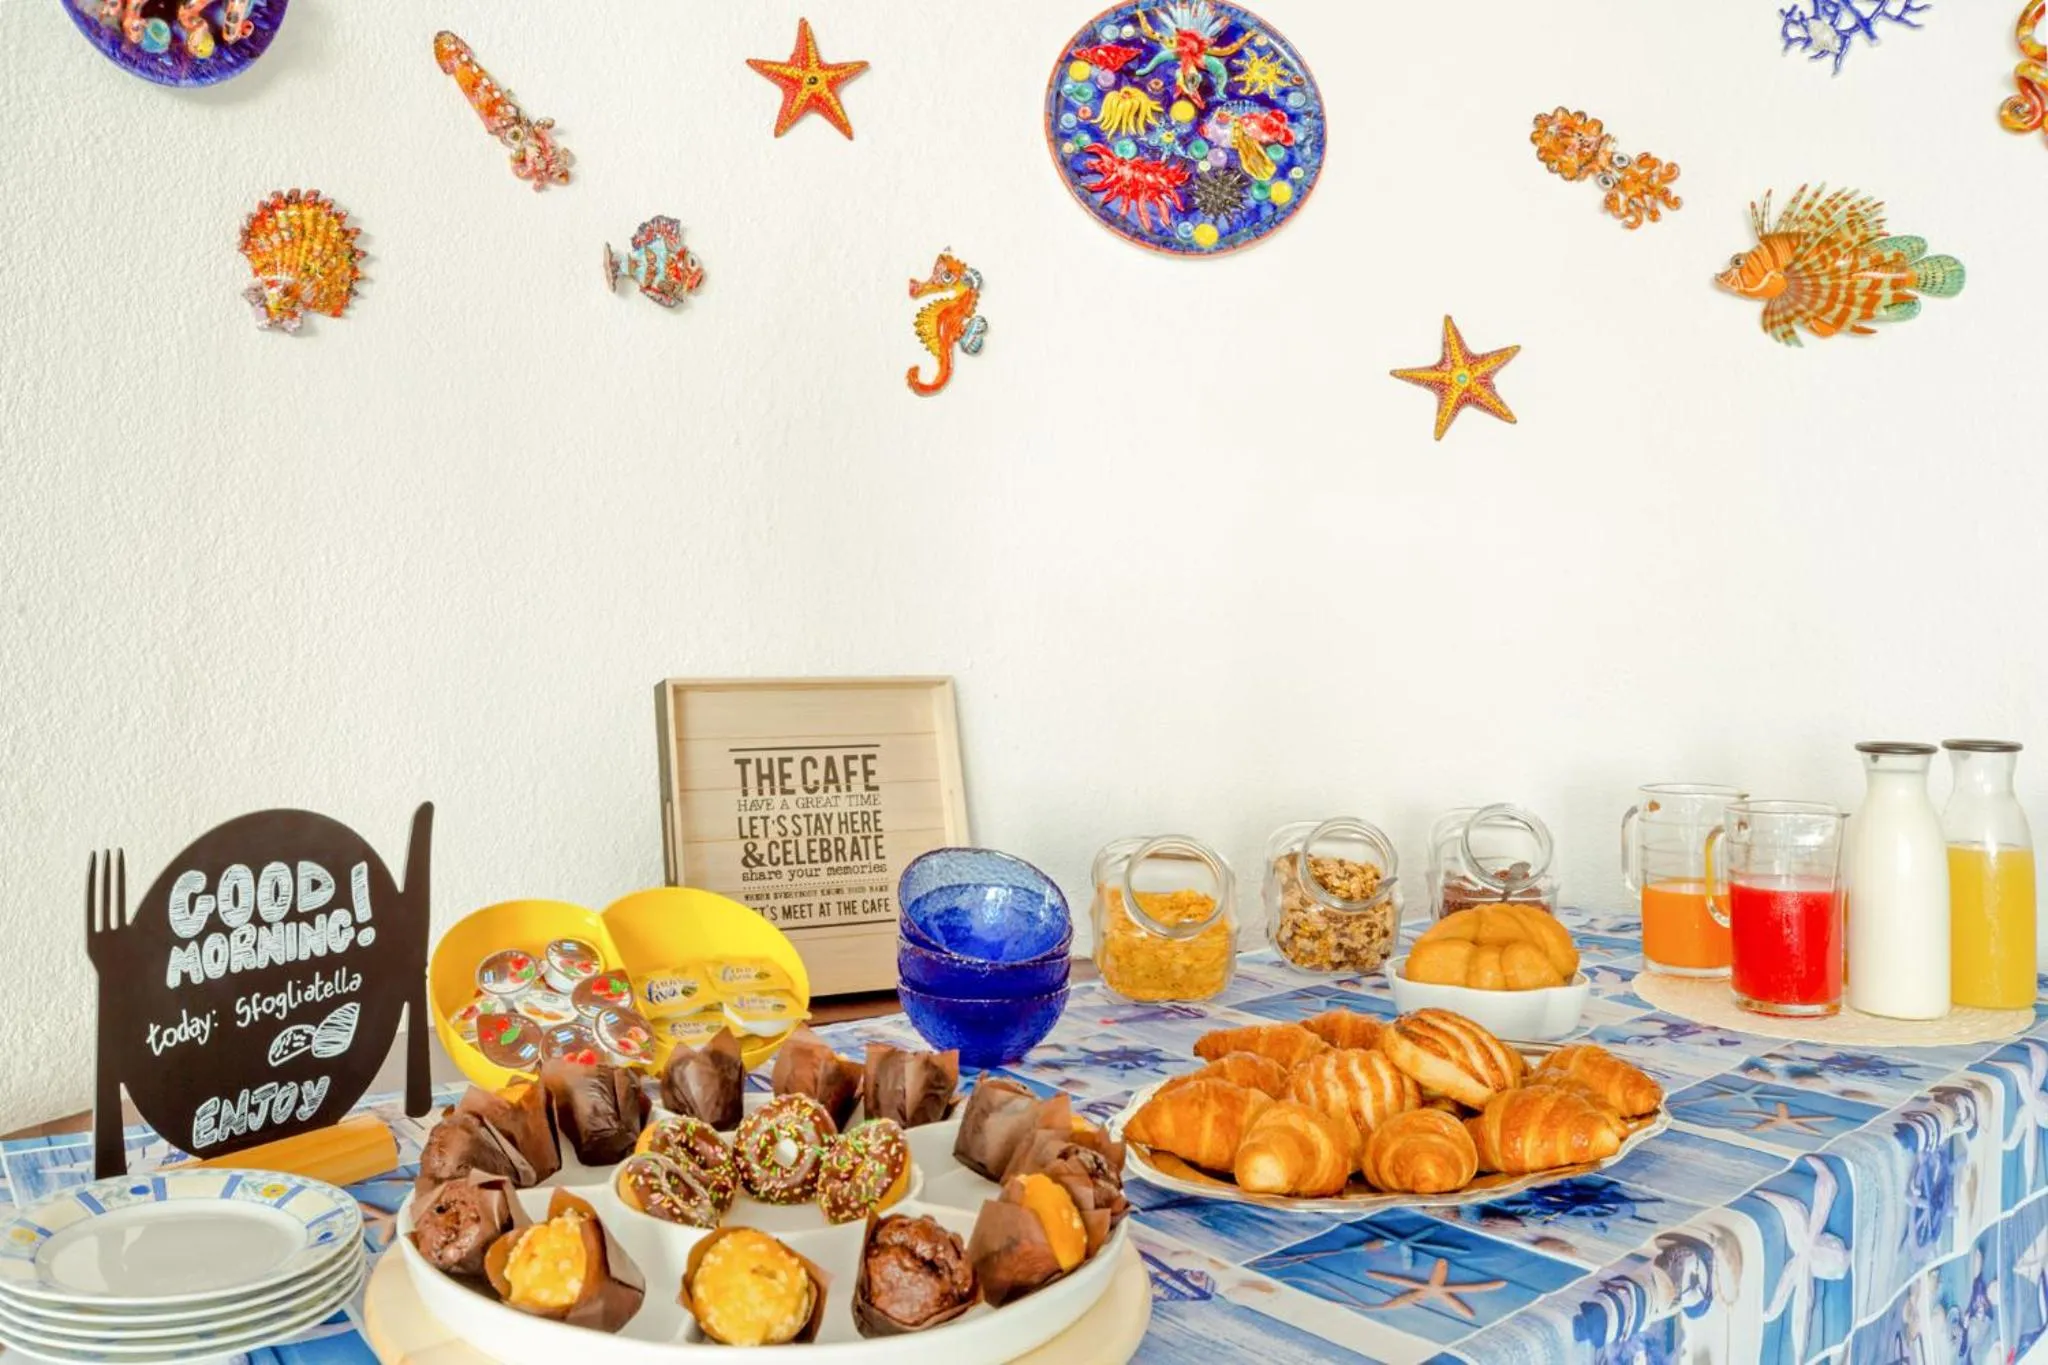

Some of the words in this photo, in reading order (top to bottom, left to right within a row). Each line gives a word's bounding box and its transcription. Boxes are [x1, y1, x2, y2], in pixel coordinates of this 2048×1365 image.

[734, 757, 796, 797] THE
[801, 755, 880, 795] CAFE
[737, 799, 775, 812] HAVE
[780, 798, 790, 810] A
[795, 795, 840, 809] GREAT
[848, 793, 882, 807] TIME
[738, 814, 788, 839] LET'S
[791, 812, 834, 837] STAY
[838, 810, 883, 834] HERE
[742, 869, 783, 882] share
[788, 868, 822, 882] your
[827, 863, 888, 876] memories
[782, 902, 813, 920] MEET
[819, 901, 832, 917] AT
[837, 900, 858, 916] THE
[862, 898, 891, 914] CAFE
[147, 1009, 219, 1056] today:
[193, 1075, 331, 1149] ENJOY
